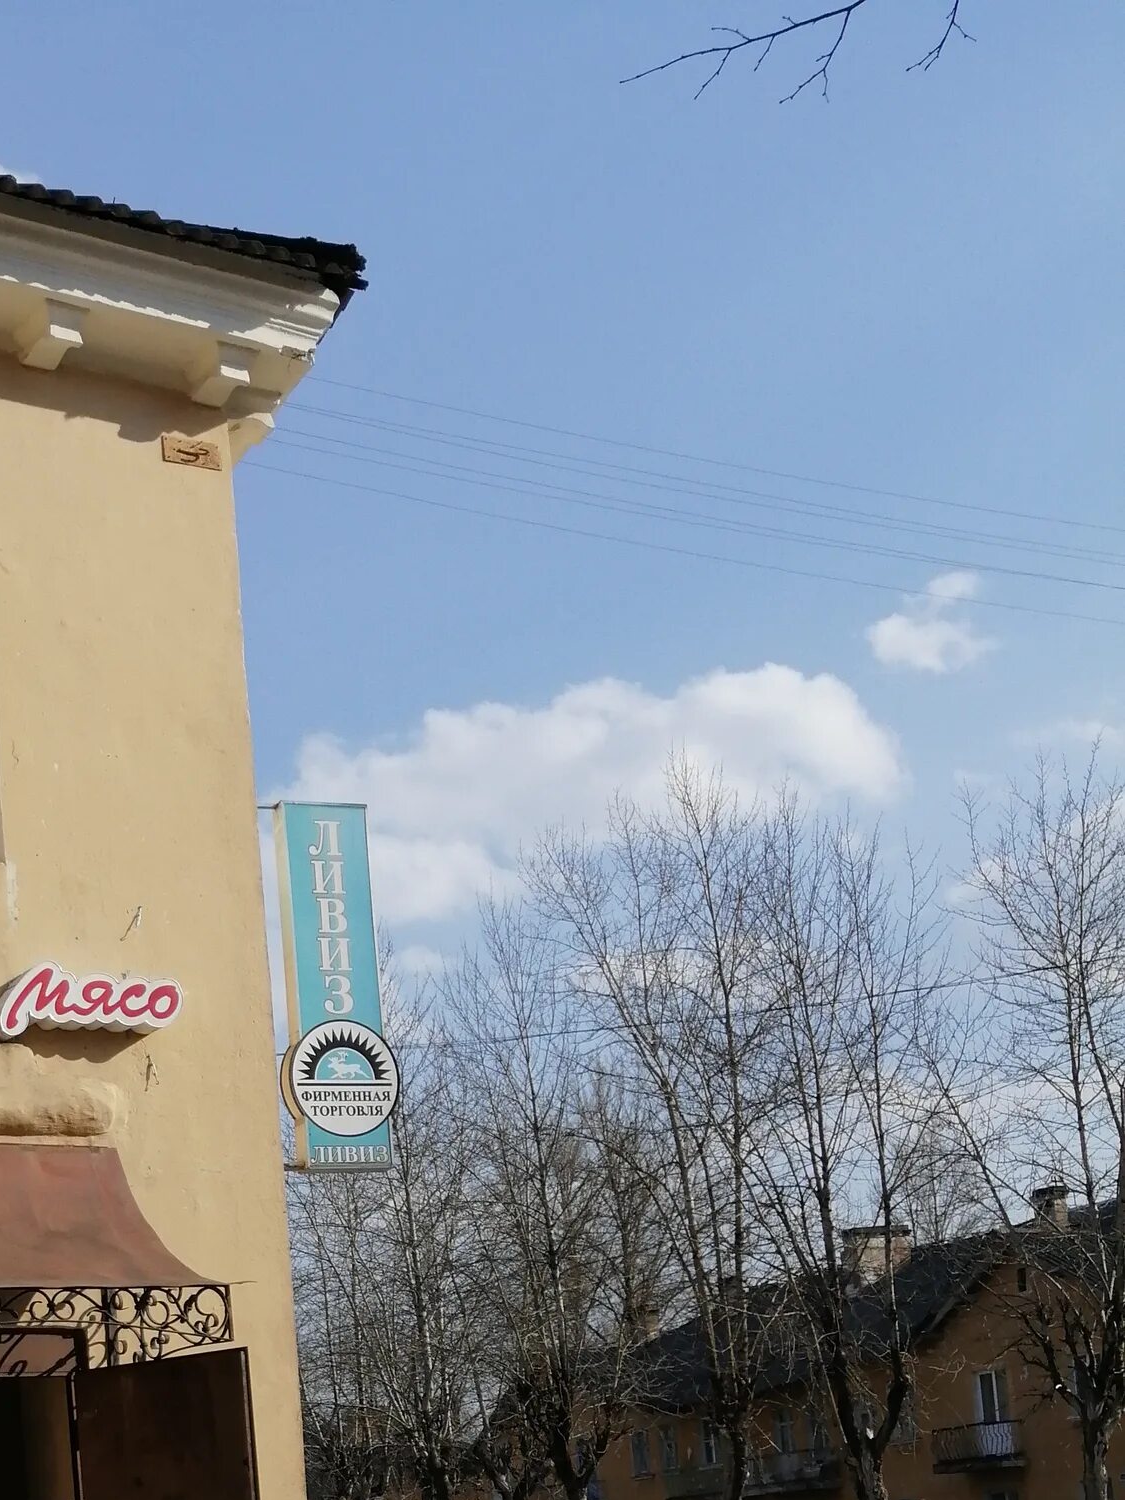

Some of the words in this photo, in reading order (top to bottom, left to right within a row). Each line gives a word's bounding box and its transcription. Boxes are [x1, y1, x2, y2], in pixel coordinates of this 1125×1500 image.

[308, 819, 354, 1016] ЛИВИЗ
[301, 1089, 392, 1104] ФИРМЕННАЯ
[310, 1104, 384, 1118] ТОРГОВЛЯ
[309, 1144, 389, 1165] ЛИВИЗ
